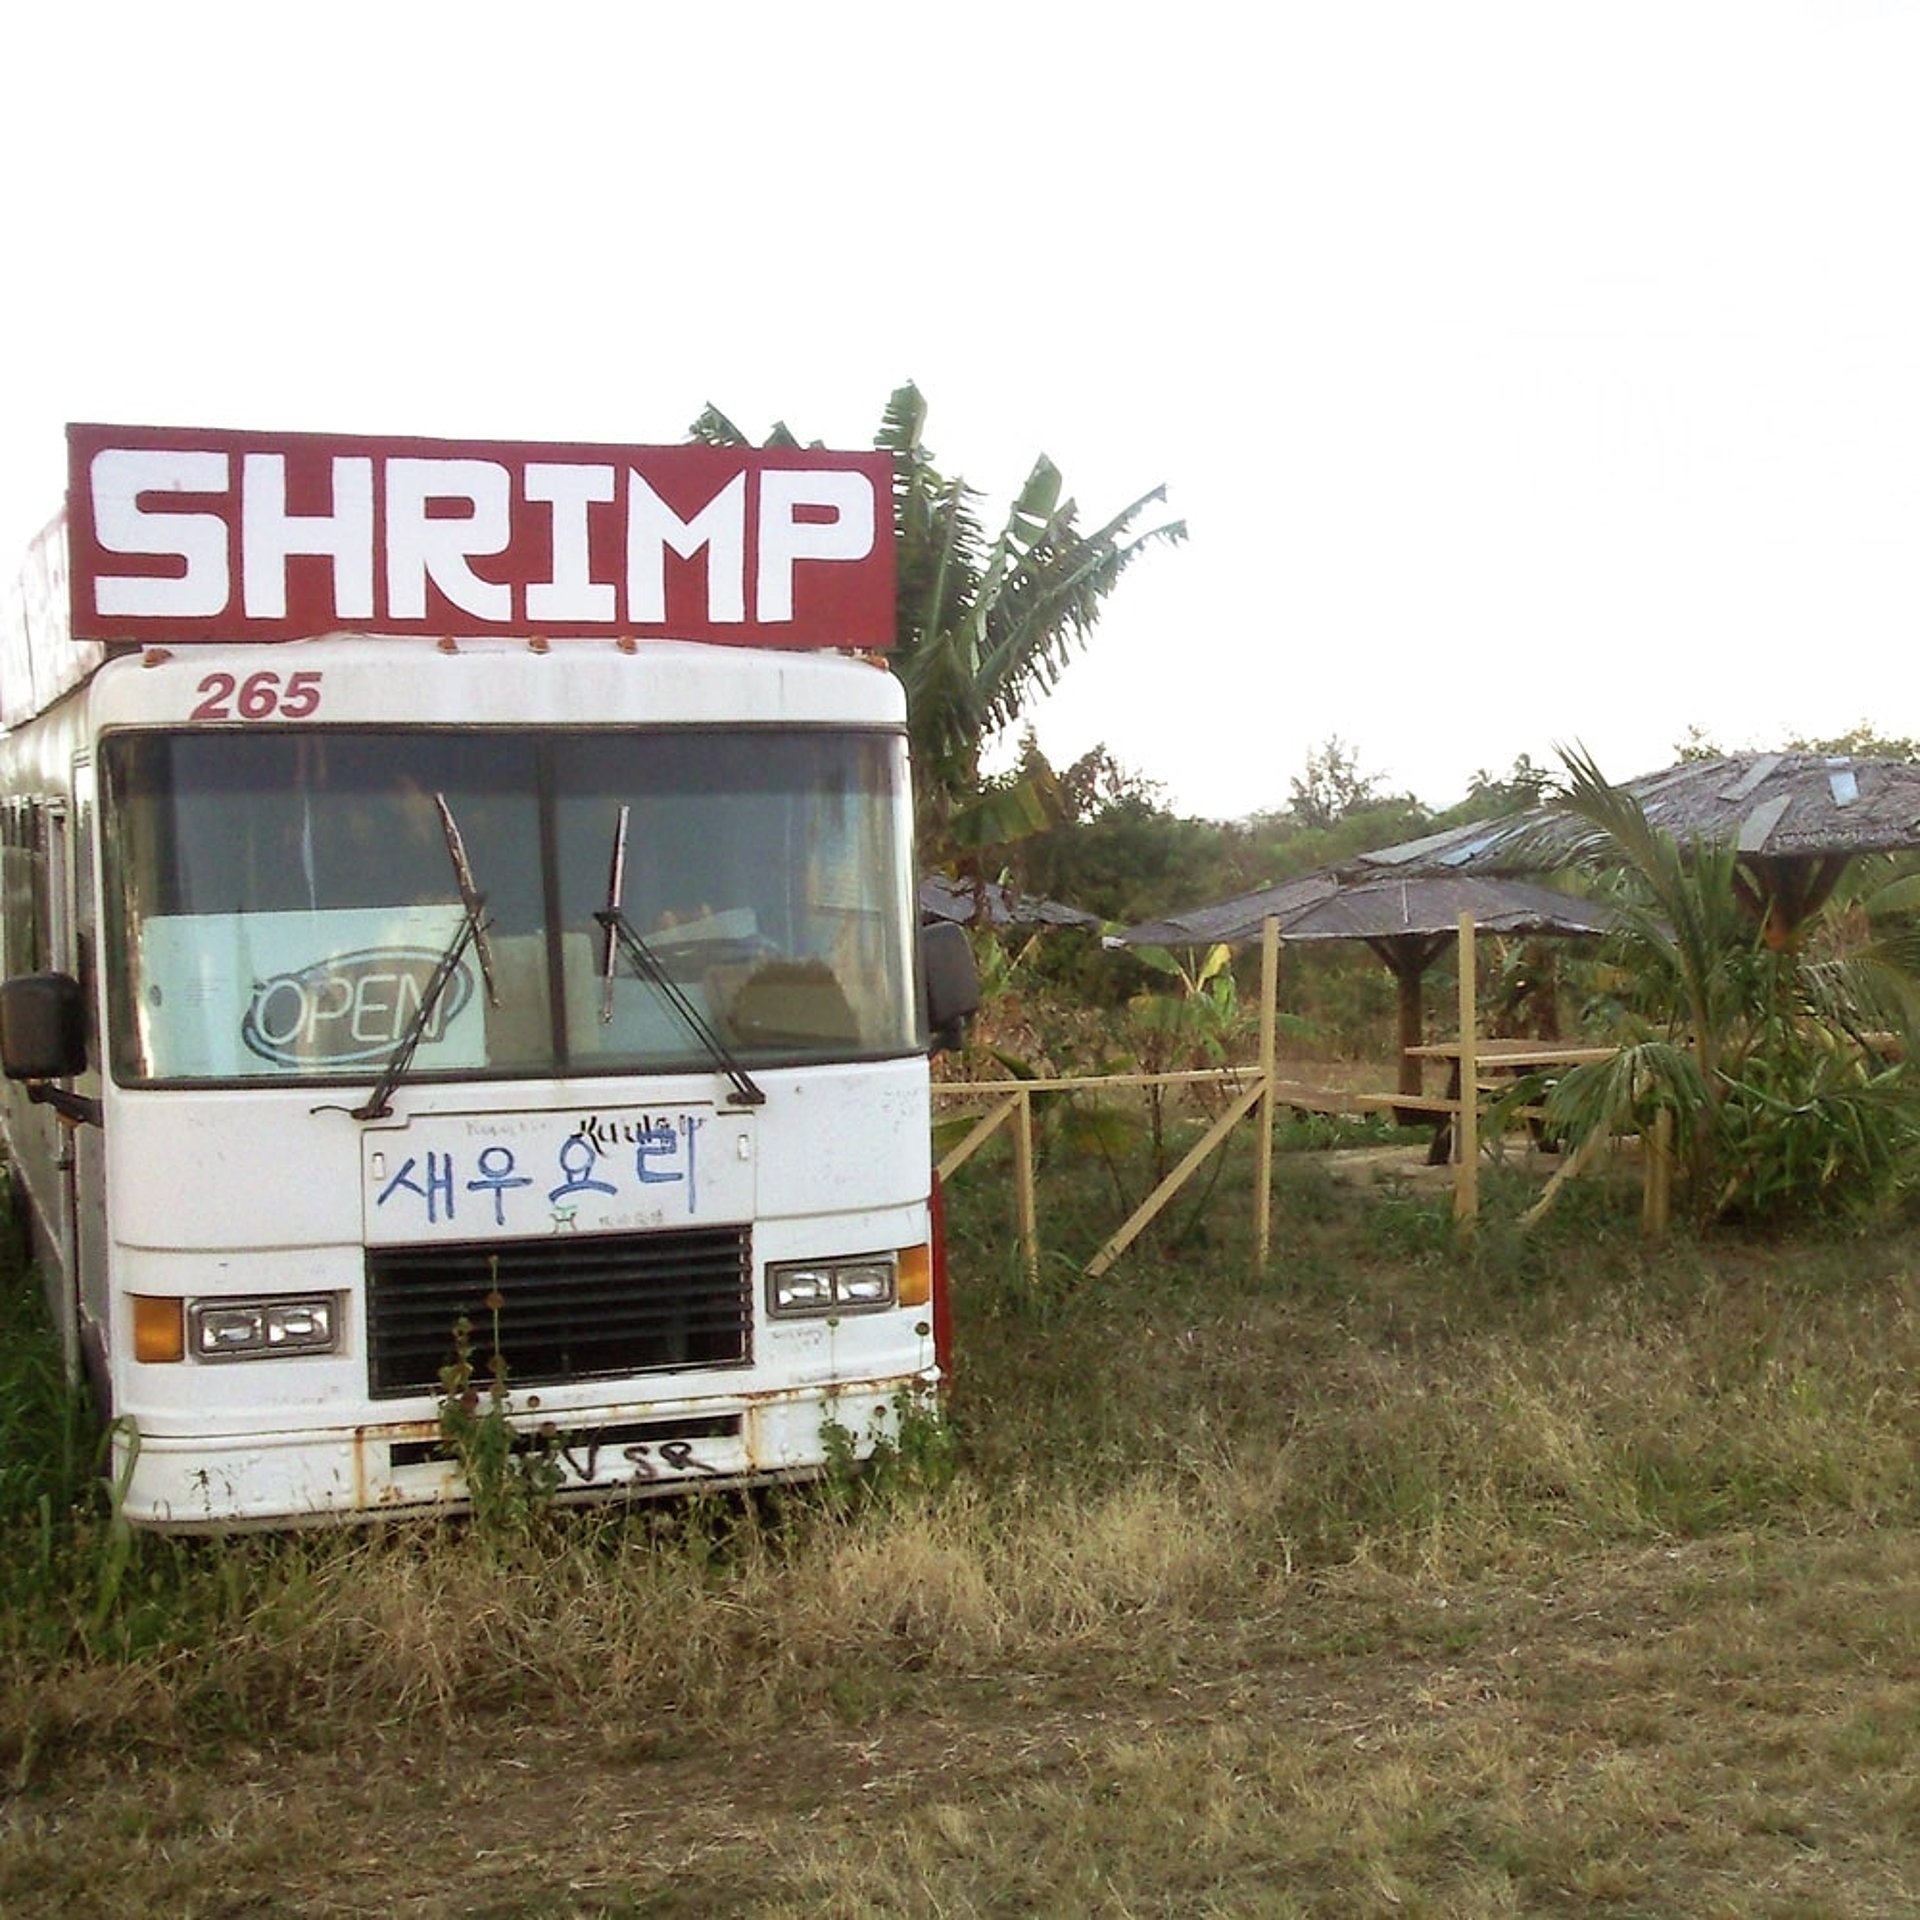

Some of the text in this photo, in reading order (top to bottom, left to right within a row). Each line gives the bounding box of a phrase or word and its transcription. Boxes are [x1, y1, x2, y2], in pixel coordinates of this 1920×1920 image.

[90, 448, 875, 623] SHRIMP
[190, 672, 322, 722] 265
[256, 973, 446, 1046] OPEN
